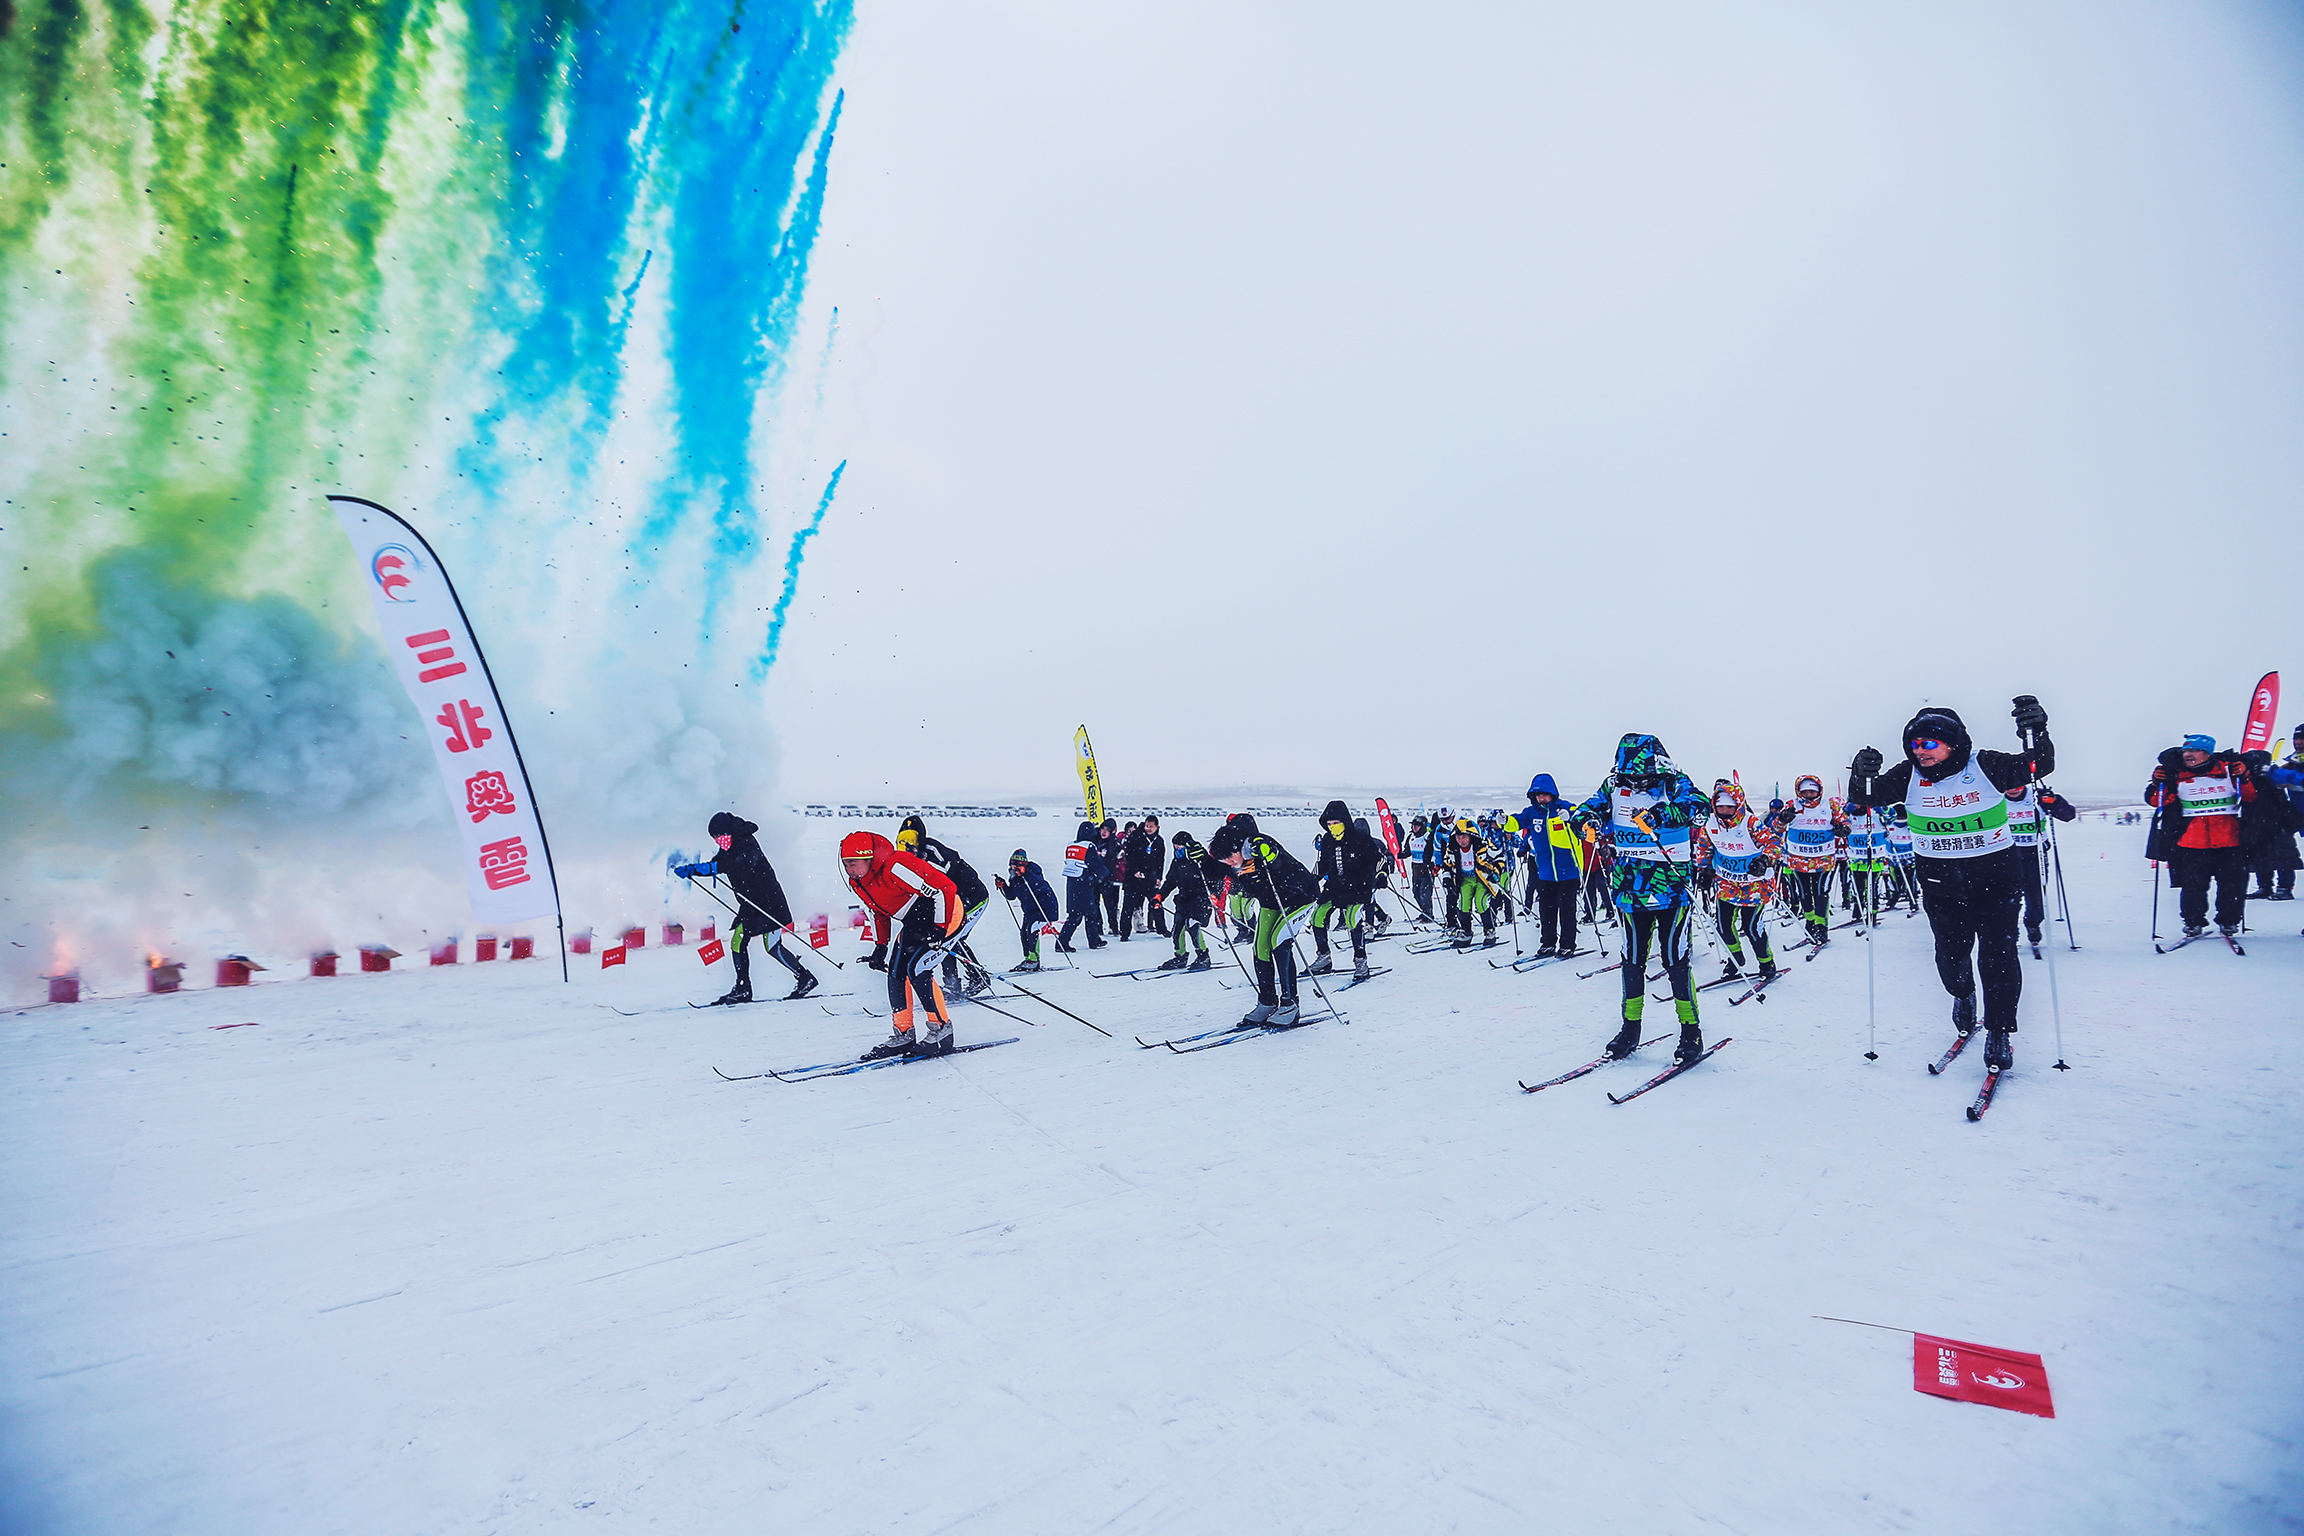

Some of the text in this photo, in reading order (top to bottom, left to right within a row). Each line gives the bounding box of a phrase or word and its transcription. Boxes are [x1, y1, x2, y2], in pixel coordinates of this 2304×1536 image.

[1921, 790, 1981, 809] 三北奥雪
[1926, 816, 1985, 832] 0811
[1798, 831, 1826, 844] 0625
[1930, 834, 1986, 851] 越野滑雪赛
[1938, 1347, 1960, 1387] 三北奥雪
